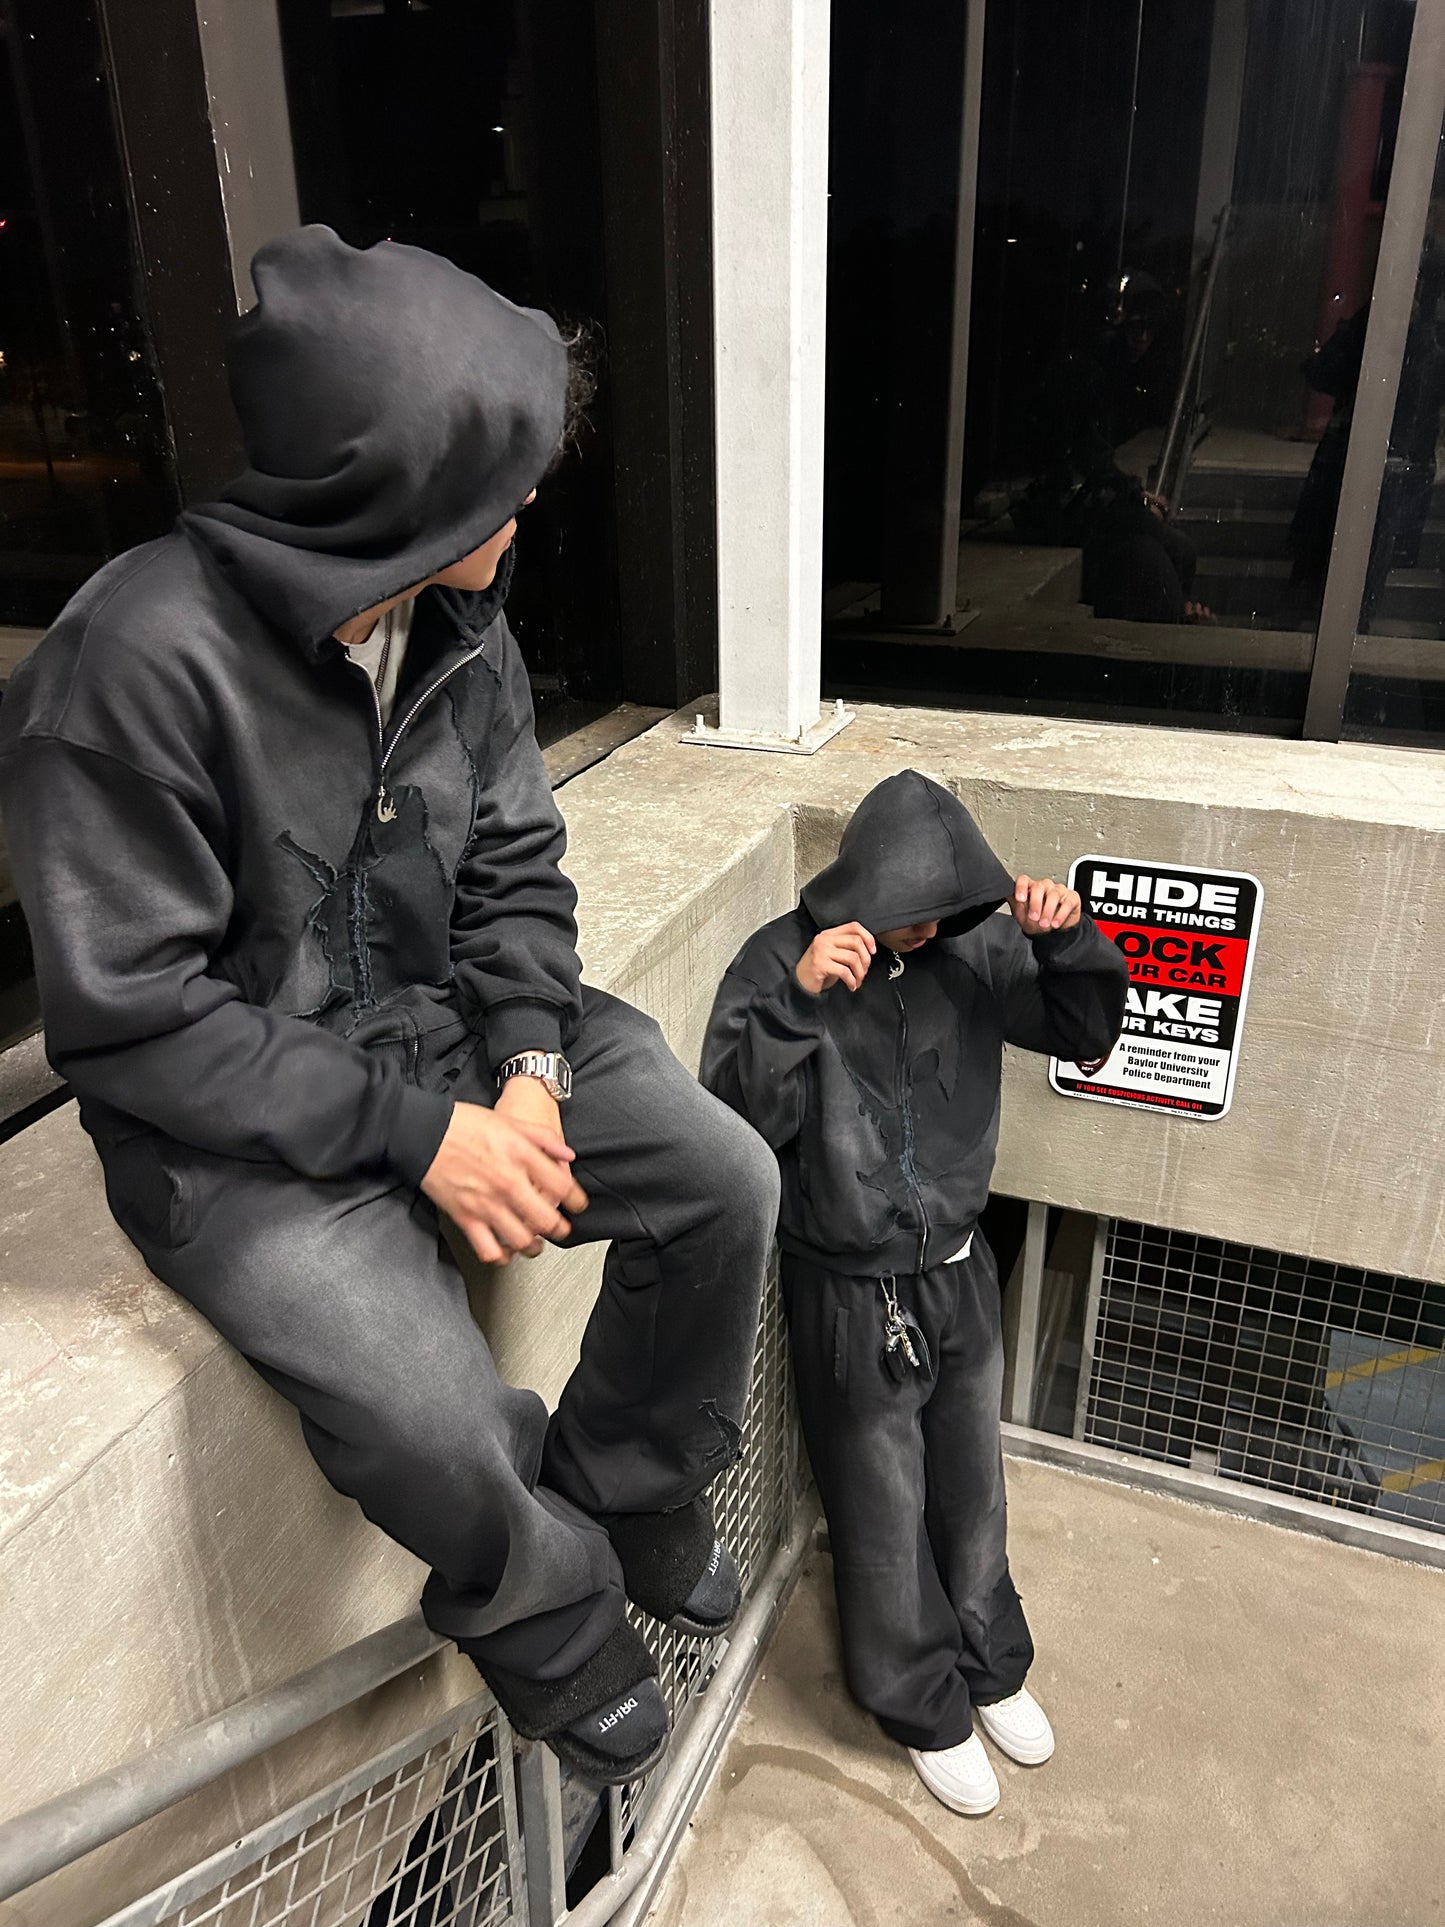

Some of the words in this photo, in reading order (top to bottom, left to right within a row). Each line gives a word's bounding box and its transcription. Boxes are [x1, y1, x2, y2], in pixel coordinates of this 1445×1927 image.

[1090, 870, 1240, 915] HIDE
[1090, 900, 1147, 919] YOUR
[1153, 909, 1236, 931] THINGS
[1114, 931, 1227, 970] OCK
[1129, 963, 1160, 978] UR
[1168, 967, 1227, 988] CAR
[1124, 987, 1222, 1026] AKE
[1152, 1020, 1219, 1043] KEYS
[1119, 1042, 1126, 1052] A
[1127, 1045, 1172, 1059] reminder
[1173, 1051, 1196, 1063] from
[1198, 1056, 1220, 1067] your
[1127, 1056, 1158, 1069] Baylor
[1160, 1061, 1209, 1078] University
[1122, 1067, 1152, 1080] Police
[1154, 1072, 1211, 1090] Department
[1076, 1082, 1082, 1090] IF
[1083, 1084, 1096, 1092] YOU
[1096, 1086, 1107, 1094] SEE
[1107, 1088, 1146, 1100] SUSPICIOUS
[1175, 1099, 1190, 1108] CALL
[708, 1540, 721, 1577] DRI-FIT
[598, 1697, 639, 1734] DRI-FIT
